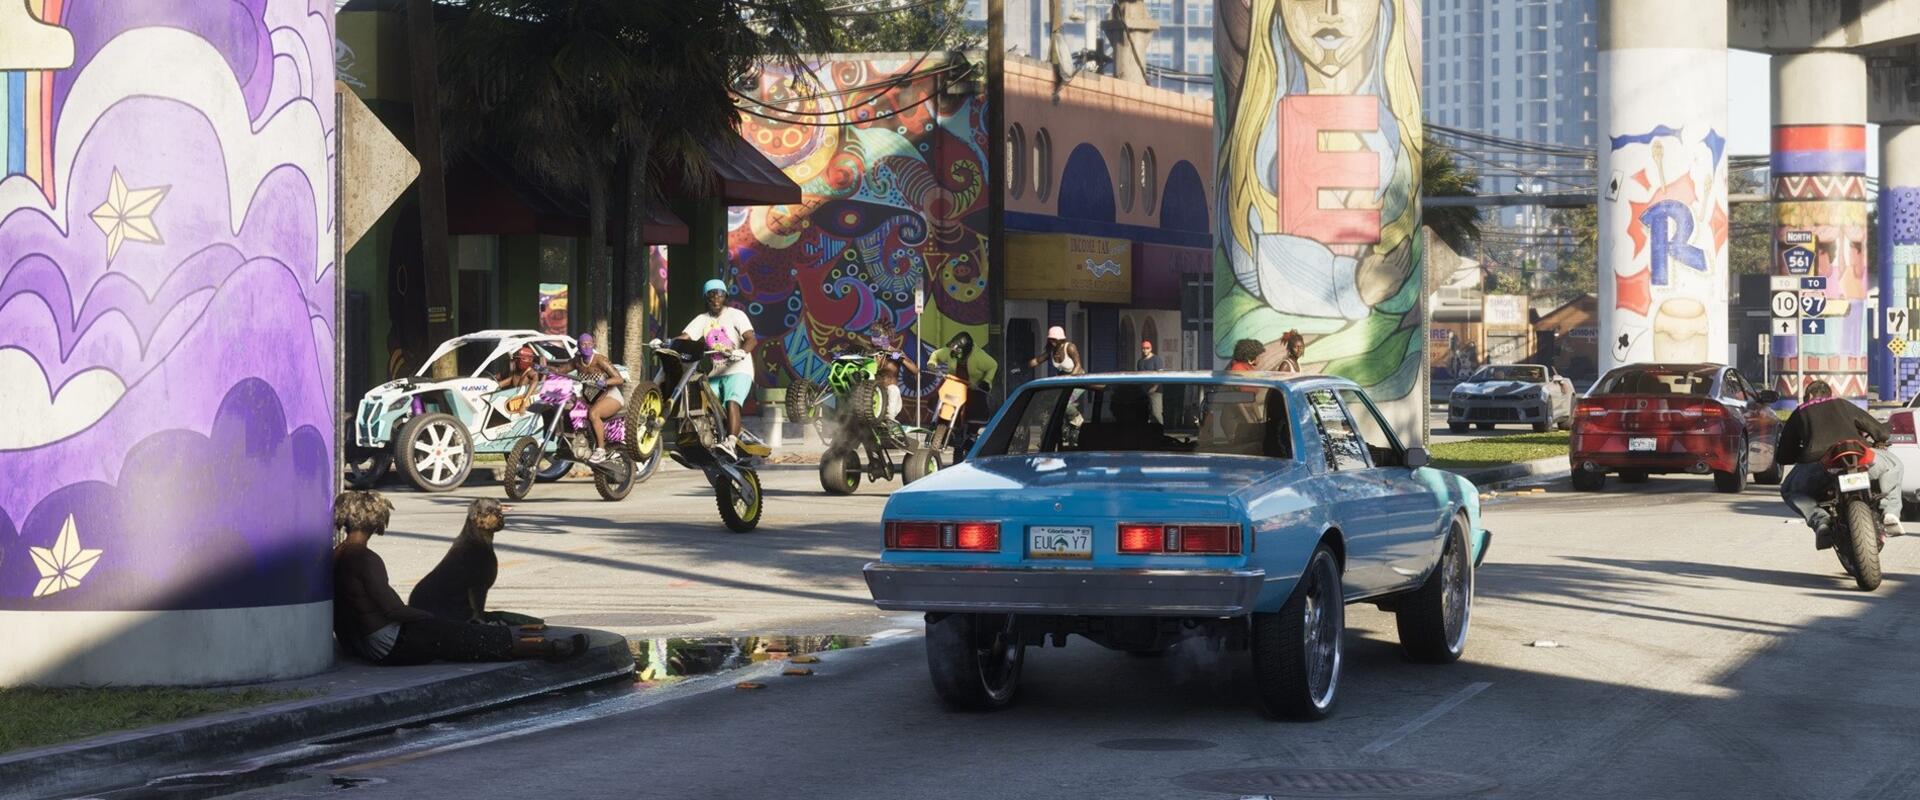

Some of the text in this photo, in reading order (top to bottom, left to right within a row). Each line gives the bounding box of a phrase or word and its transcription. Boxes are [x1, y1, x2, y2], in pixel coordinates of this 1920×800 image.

[1277, 94, 1381, 244] E
[1639, 199, 1708, 286] R
[1787, 232, 1811, 241] NORTH
[1789, 256, 1809, 268] 561
[1780, 279, 1790, 287] TO
[1778, 297, 1794, 310] 10
[1802, 297, 1824, 311] 97
[1072, 535, 1087, 550] Y7
